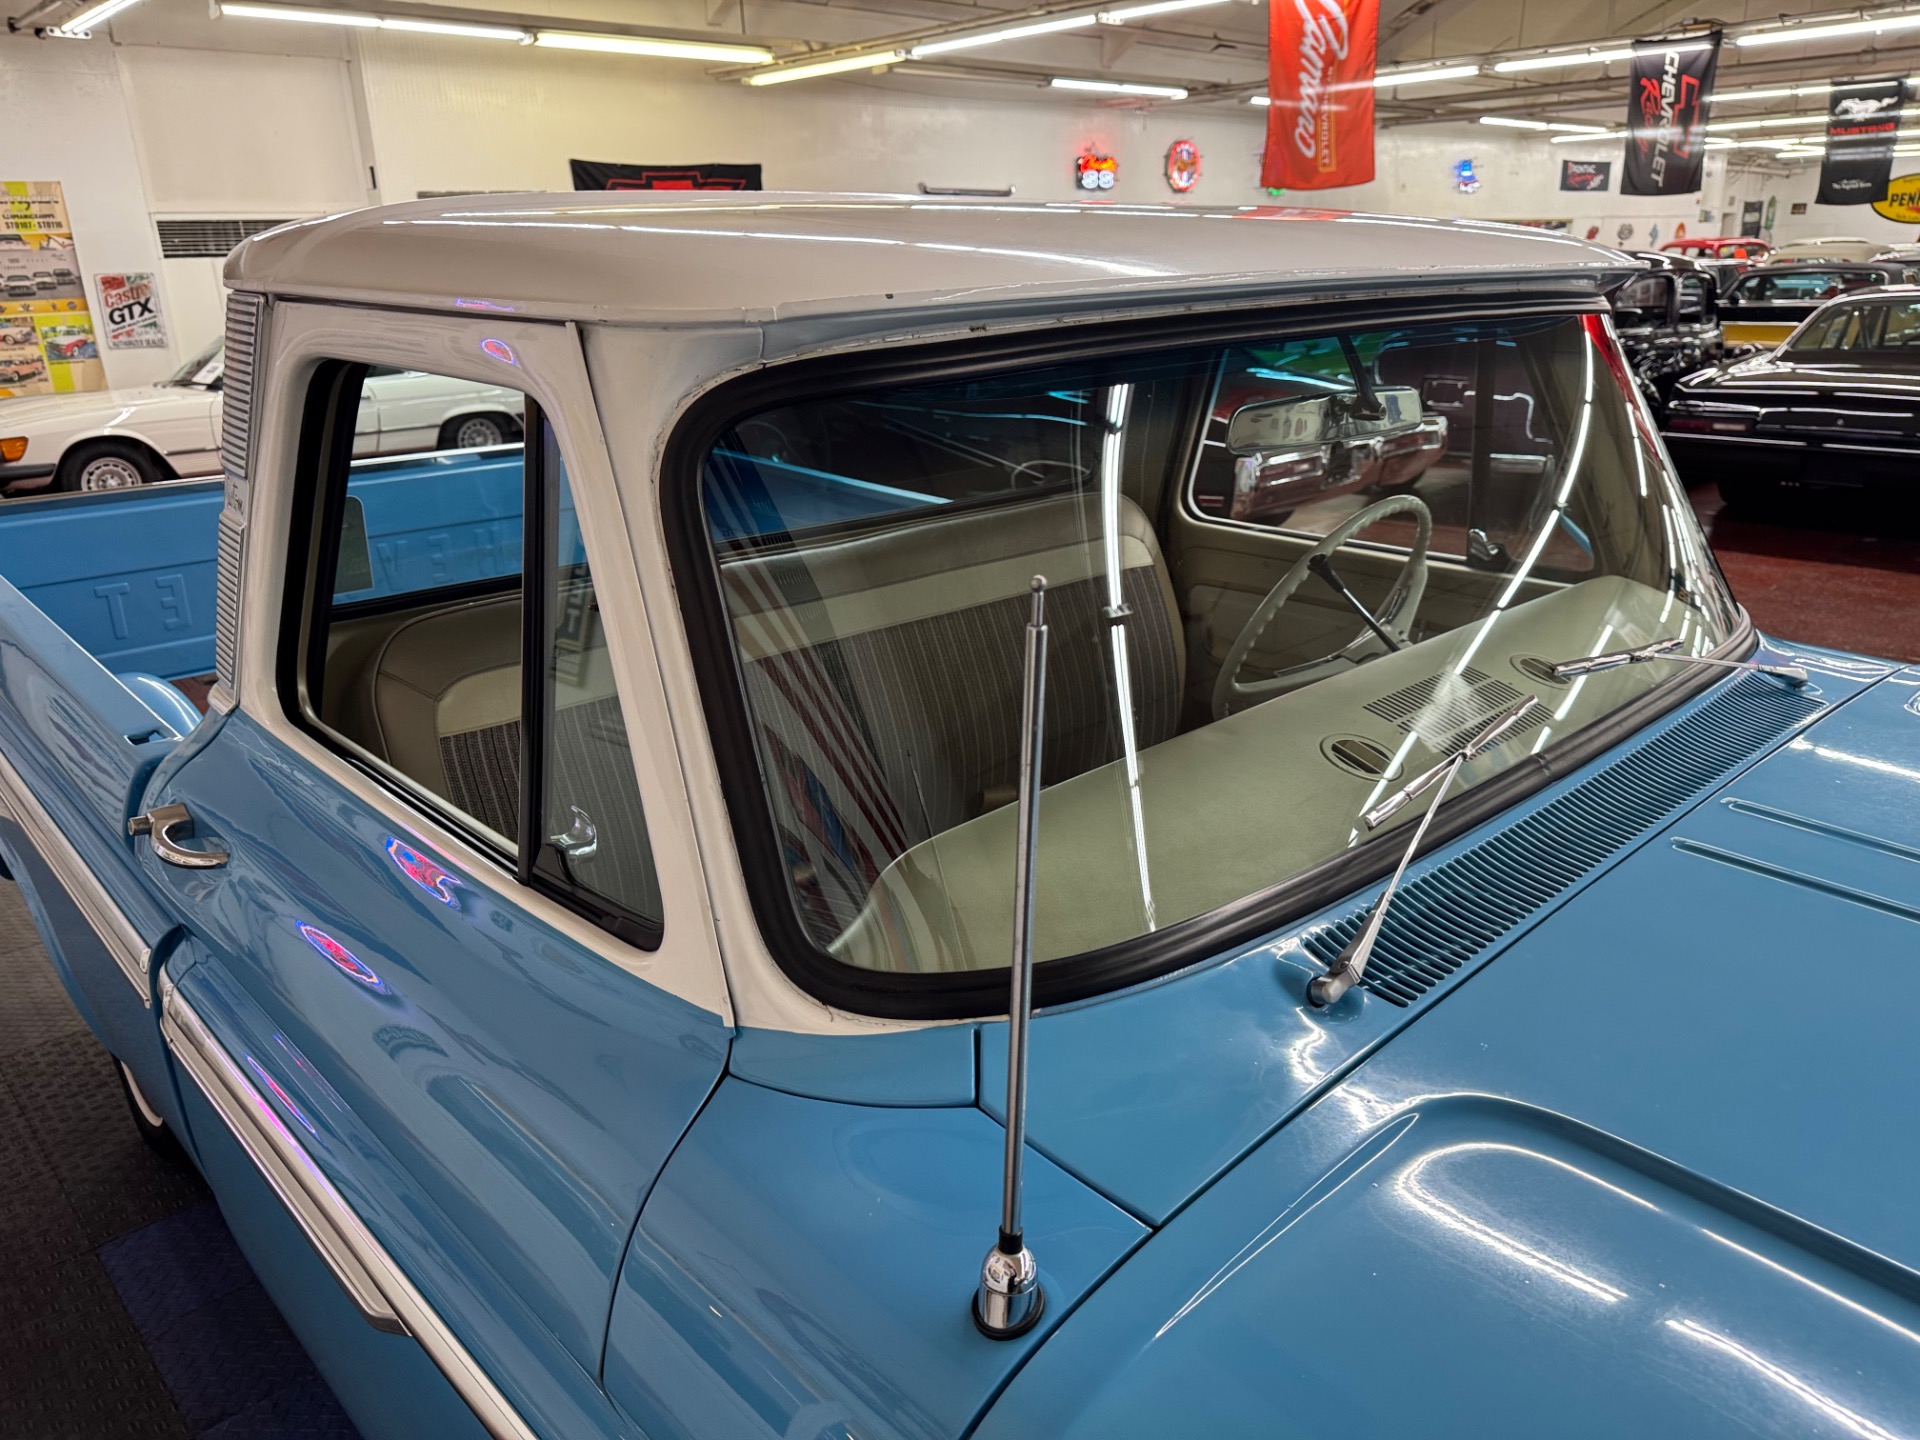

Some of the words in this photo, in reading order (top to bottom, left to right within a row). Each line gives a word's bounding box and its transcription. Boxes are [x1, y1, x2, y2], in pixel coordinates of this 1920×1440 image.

[1651, 51, 1680, 187] CHEVROLET
[1830, 122, 1895, 136] MUSTANG
[104, 281, 152, 308] Castro
[109, 296, 155, 325] GTX
